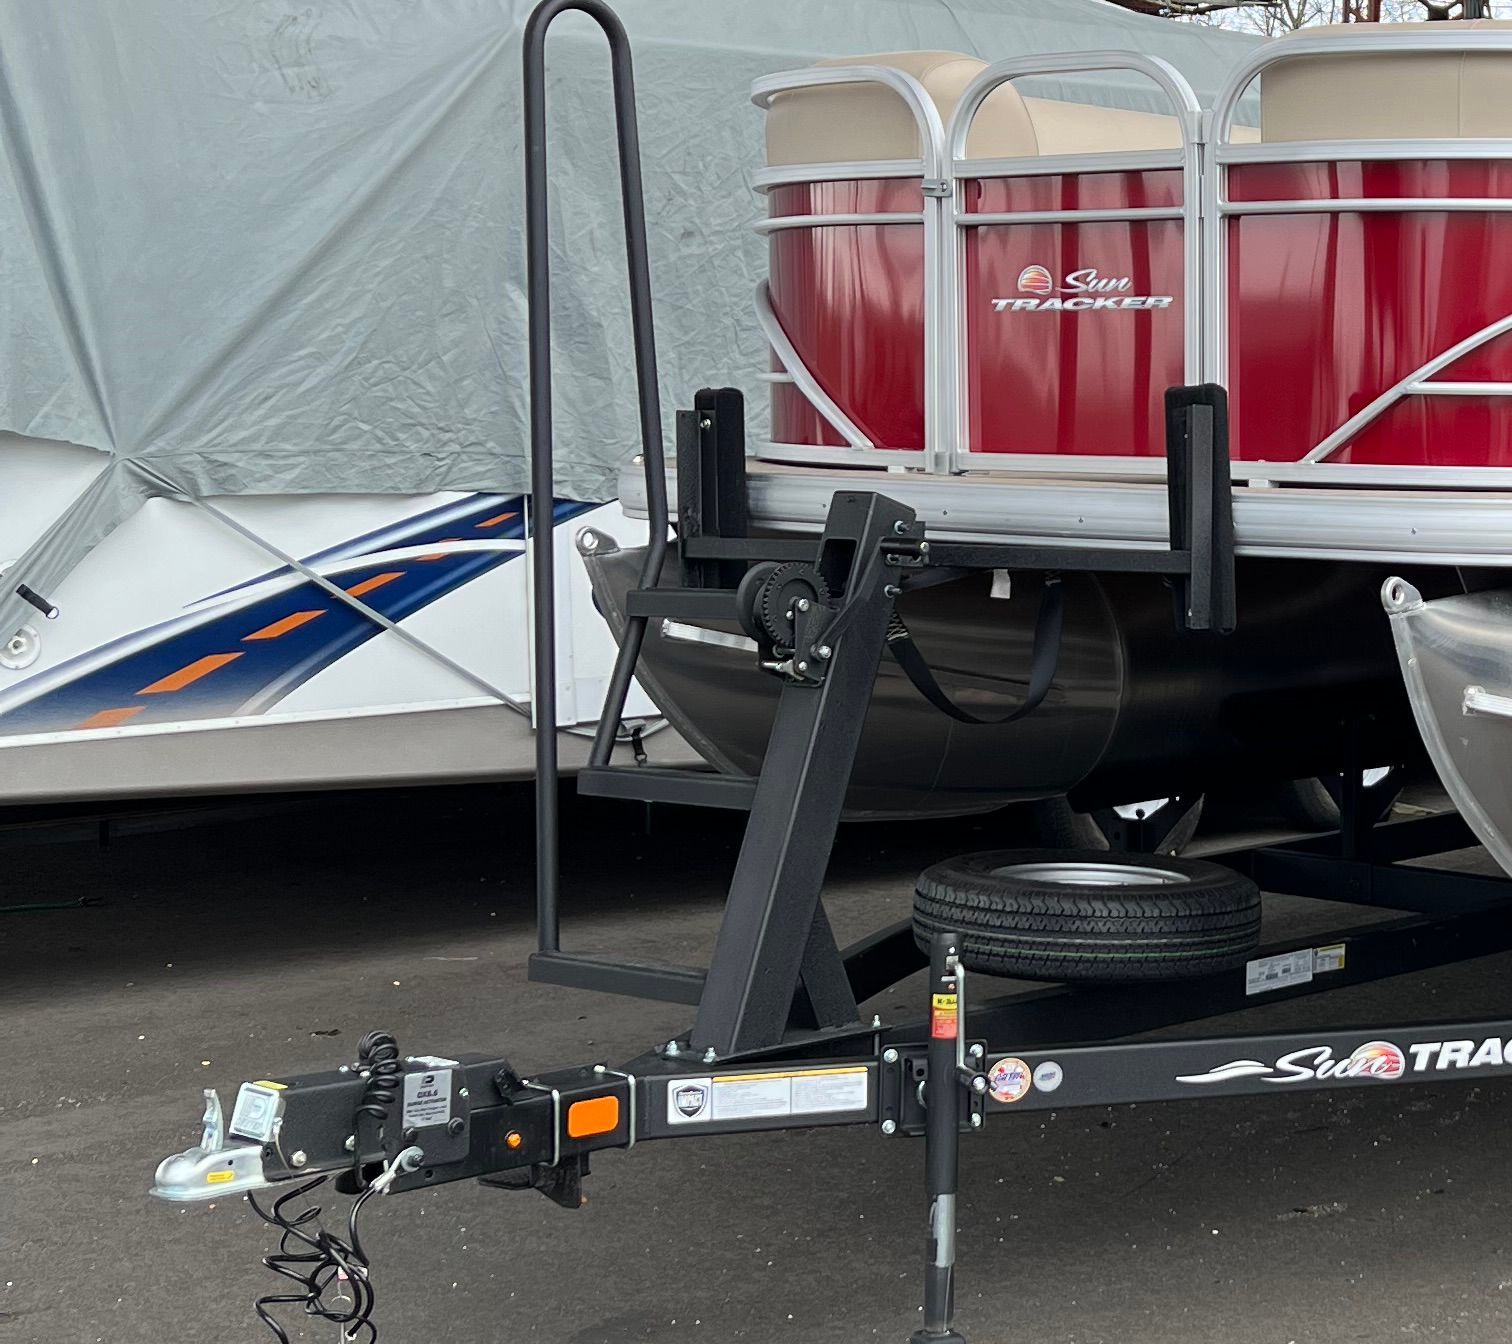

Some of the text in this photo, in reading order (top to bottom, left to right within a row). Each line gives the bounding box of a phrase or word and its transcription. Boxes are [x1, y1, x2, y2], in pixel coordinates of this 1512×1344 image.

[1055, 268, 1132, 294] Sun
[991, 295, 1174, 312] TRACKER
[1261, 1045, 1392, 1083] Sun
